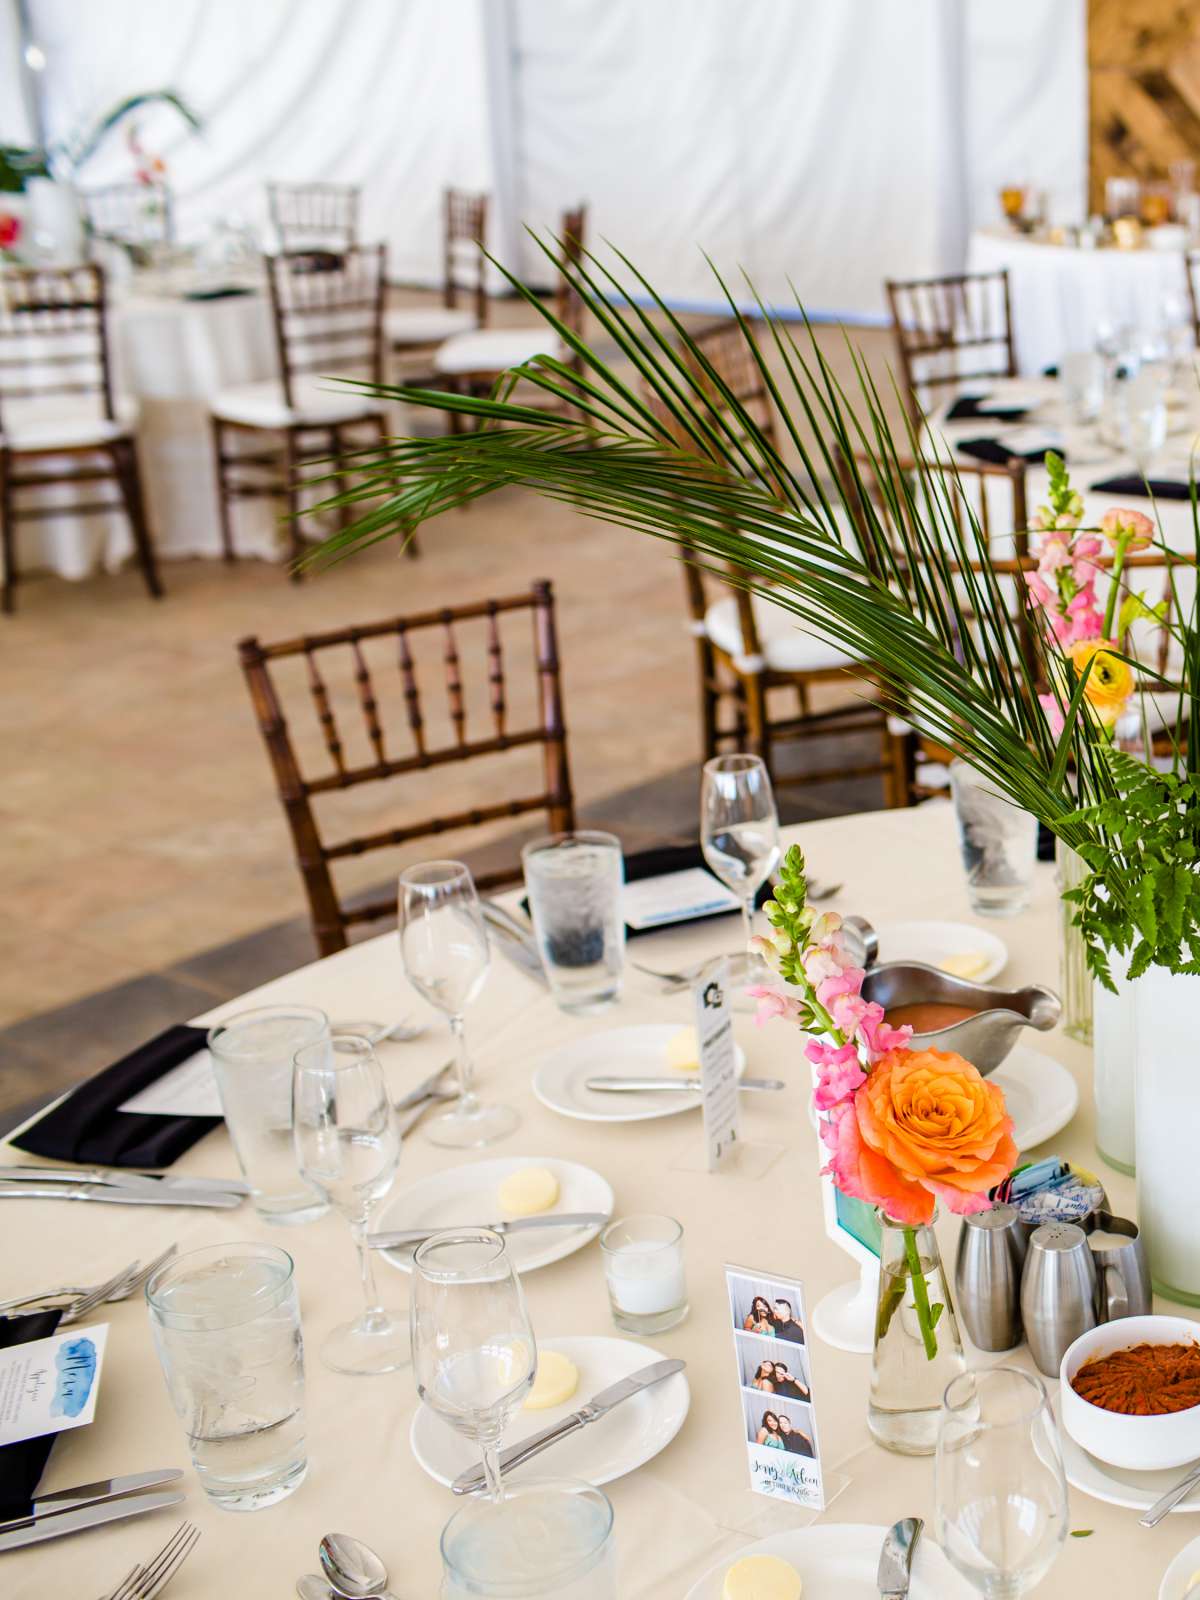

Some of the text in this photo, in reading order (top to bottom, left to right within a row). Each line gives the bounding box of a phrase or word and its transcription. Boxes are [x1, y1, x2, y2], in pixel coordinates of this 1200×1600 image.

[62, 1354, 92, 1399] Menu
[752, 1459, 778, 1481] Jerry
[789, 1467, 819, 1488] Aileen
